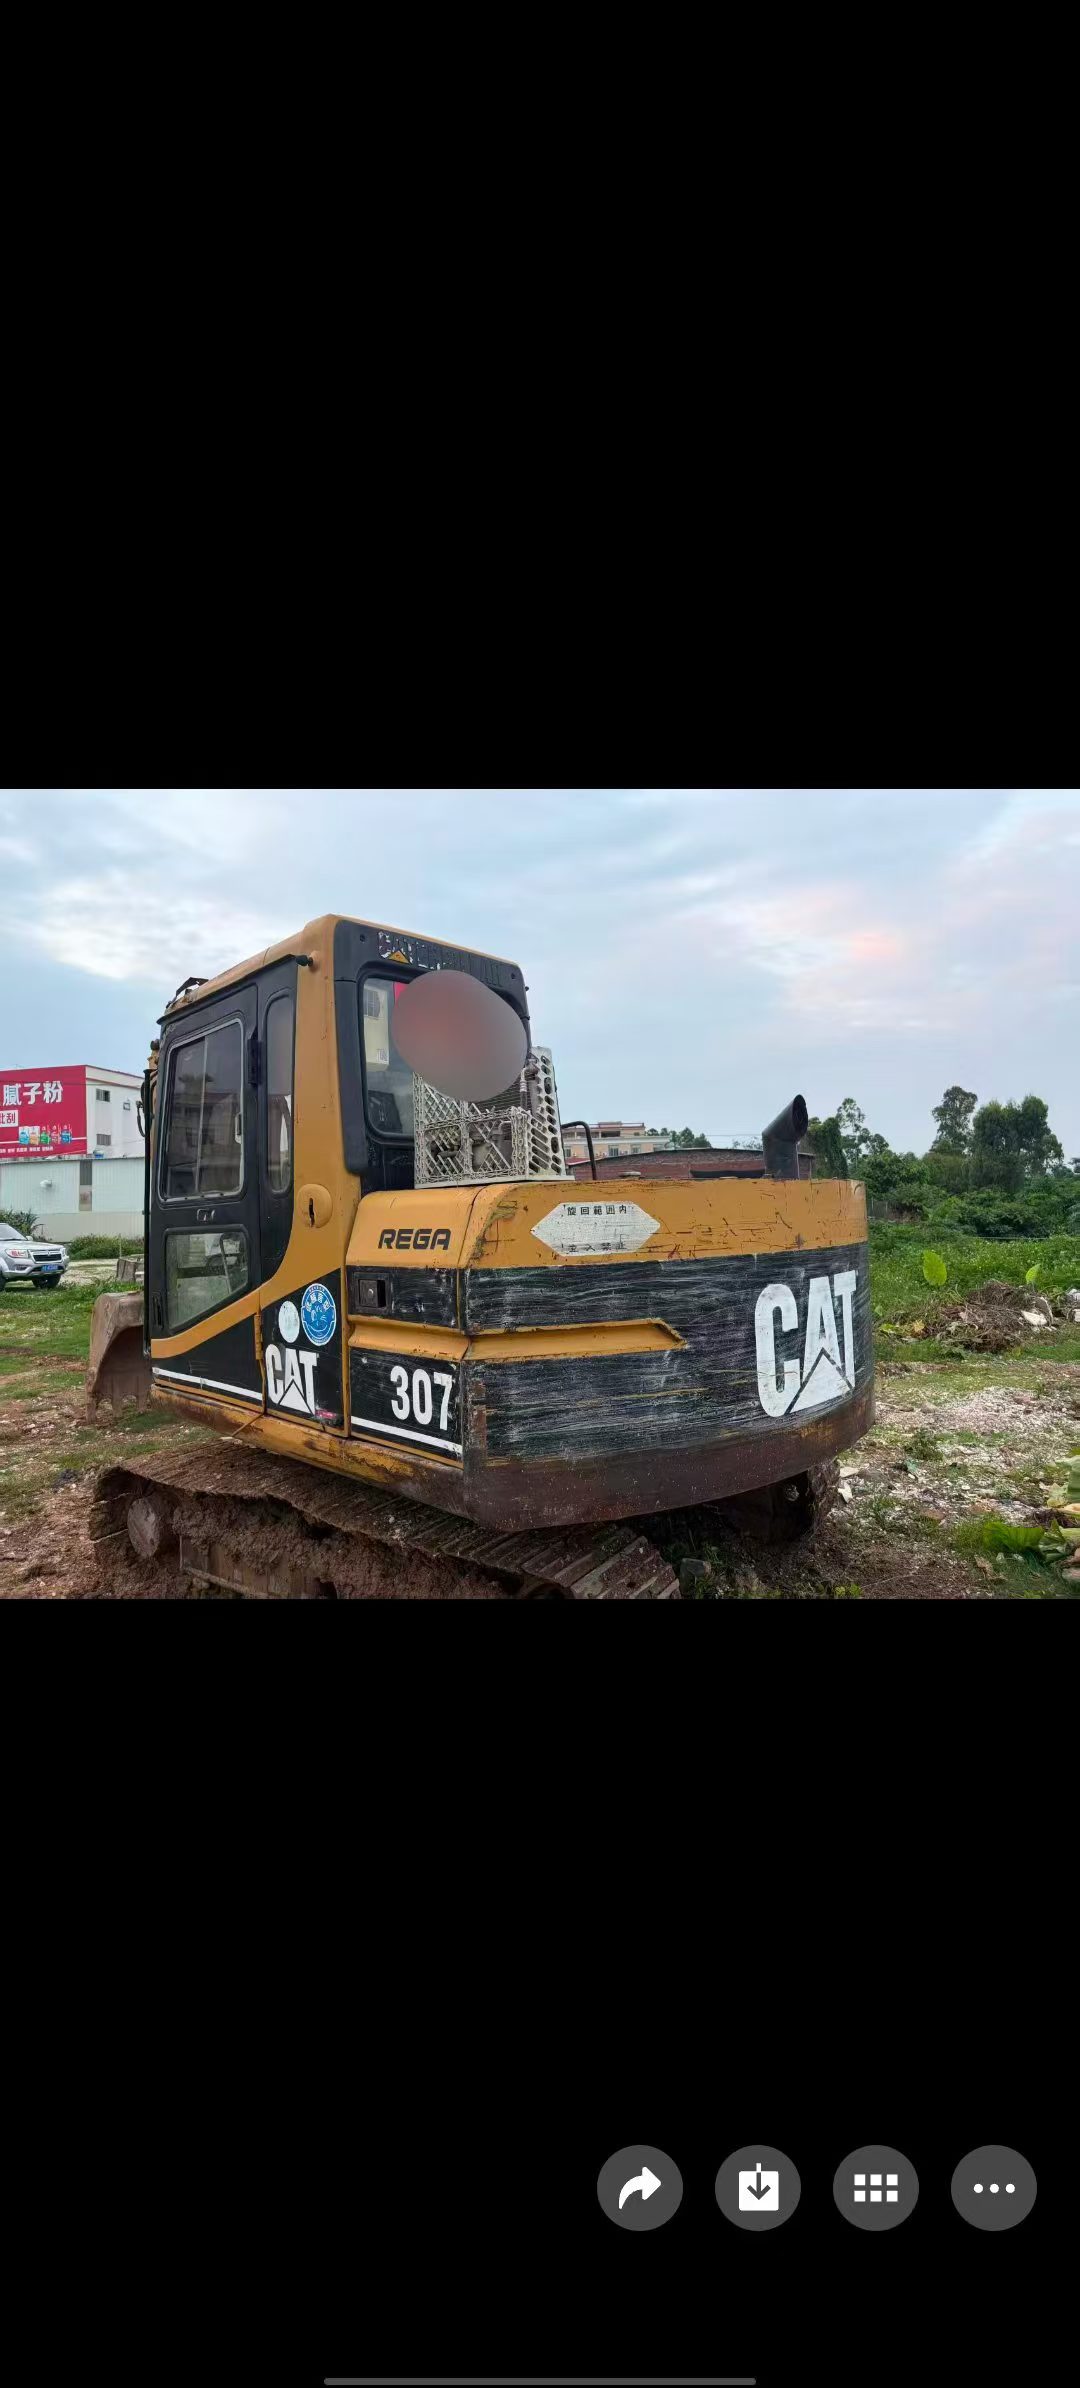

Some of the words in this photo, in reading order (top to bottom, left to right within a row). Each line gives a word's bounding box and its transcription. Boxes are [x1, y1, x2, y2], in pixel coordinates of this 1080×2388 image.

[378, 1228, 451, 1250] REGA
[755, 1270, 857, 1417] CAT
[265, 1343, 318, 1416] CAT
[390, 1365, 453, 1431] 307
